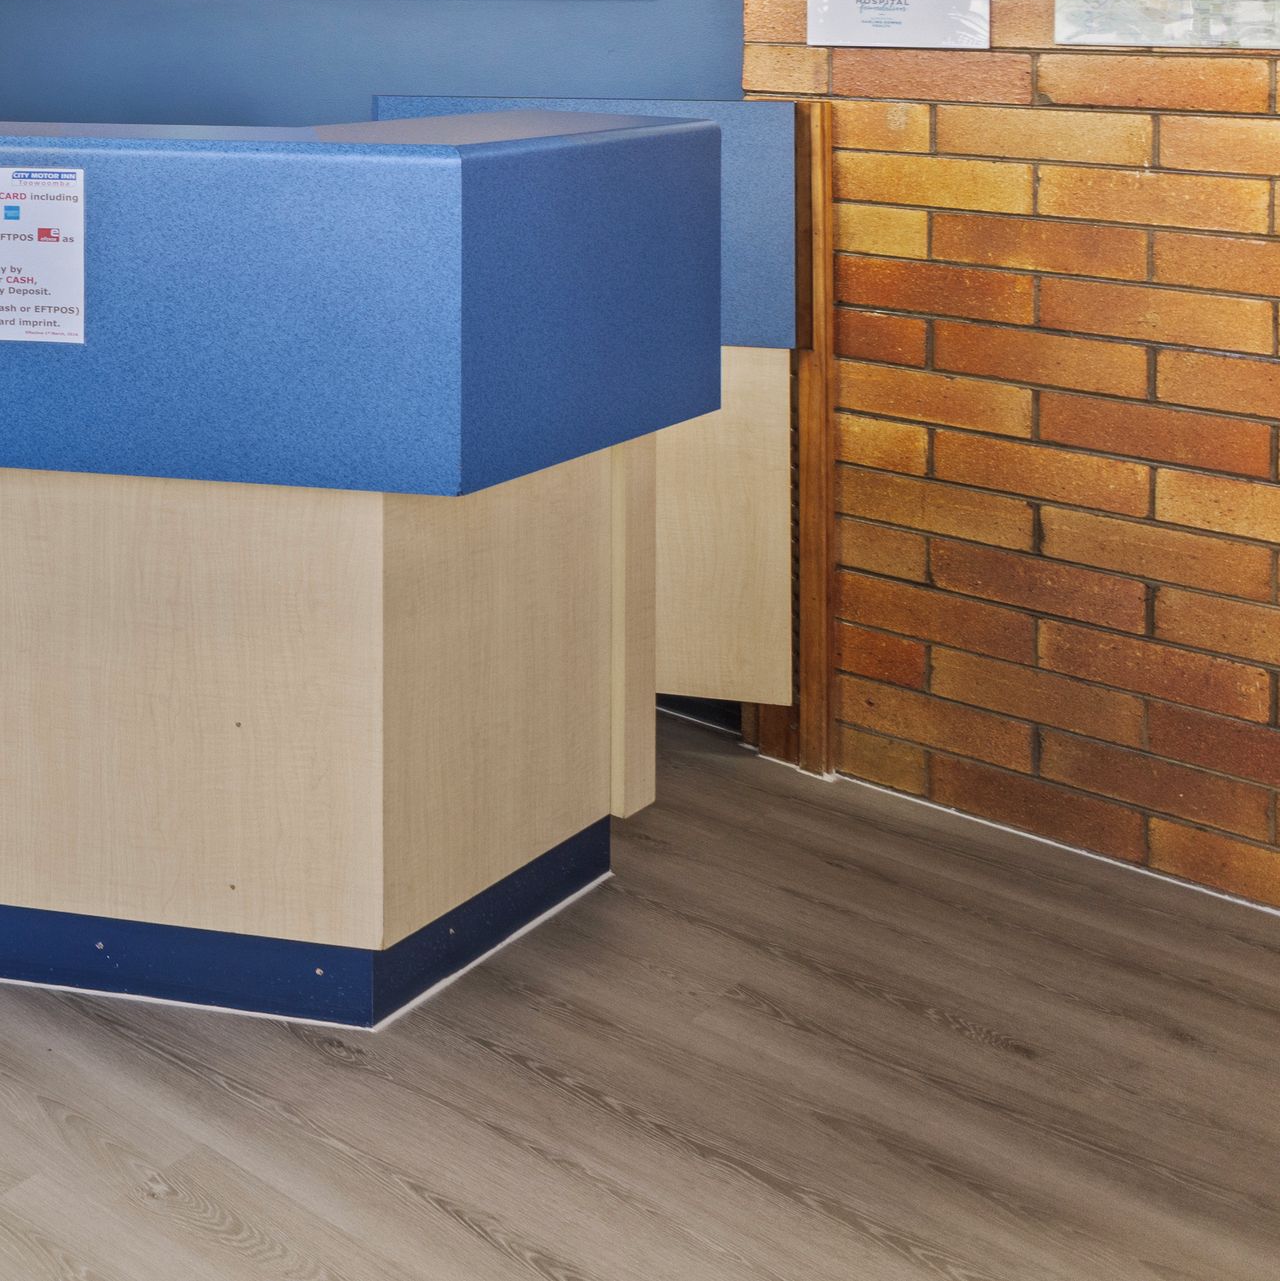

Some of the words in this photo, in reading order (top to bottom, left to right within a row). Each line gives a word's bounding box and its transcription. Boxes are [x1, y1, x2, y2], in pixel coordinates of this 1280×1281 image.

[30, 192, 79, 203] including
[62, 235, 75, 243] as
[10, 265, 23, 274] by
[6, 275, 38, 285] CASH,
[8, 286, 51, 296] Deposit.
[34, 305, 80, 316] EFTPOS)
[19, 318, 60, 328] imprint.
